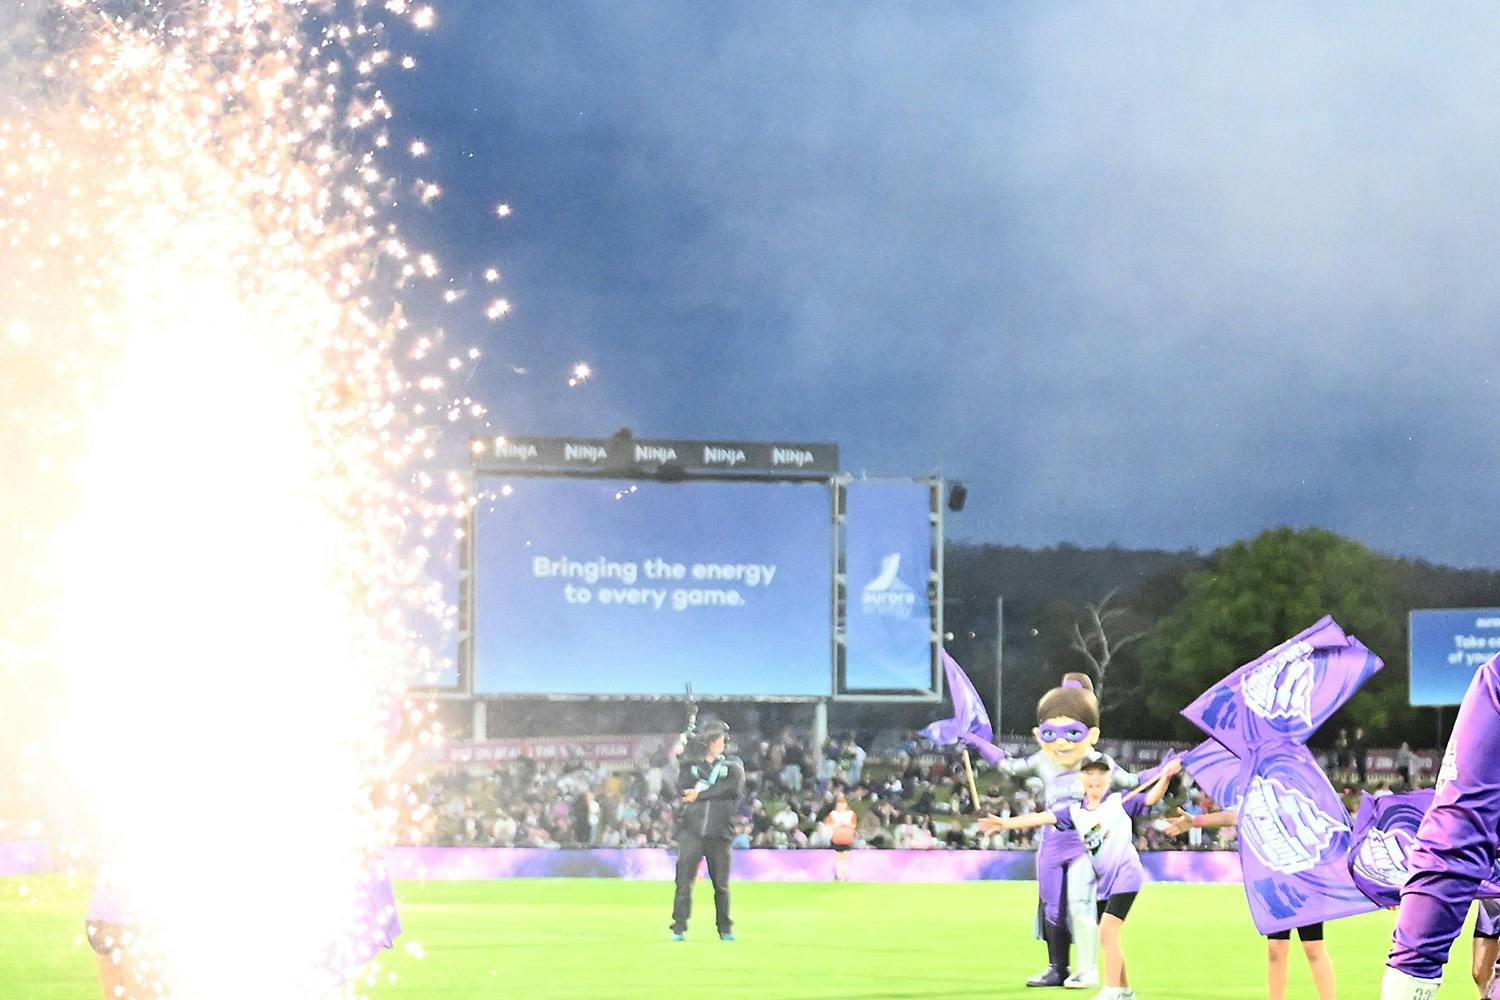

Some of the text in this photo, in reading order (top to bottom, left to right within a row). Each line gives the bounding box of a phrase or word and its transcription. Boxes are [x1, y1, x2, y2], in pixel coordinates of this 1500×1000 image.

[566, 443, 608, 463] NINJA
[635, 445, 678, 464] NINJA
[703, 446, 747, 466] NINJA
[773, 447, 814, 466] NINJA
[532, 556, 777, 586] Bringing the energy
[564, 583, 746, 612] to every game.
[1447, 650, 1463, 664] of
